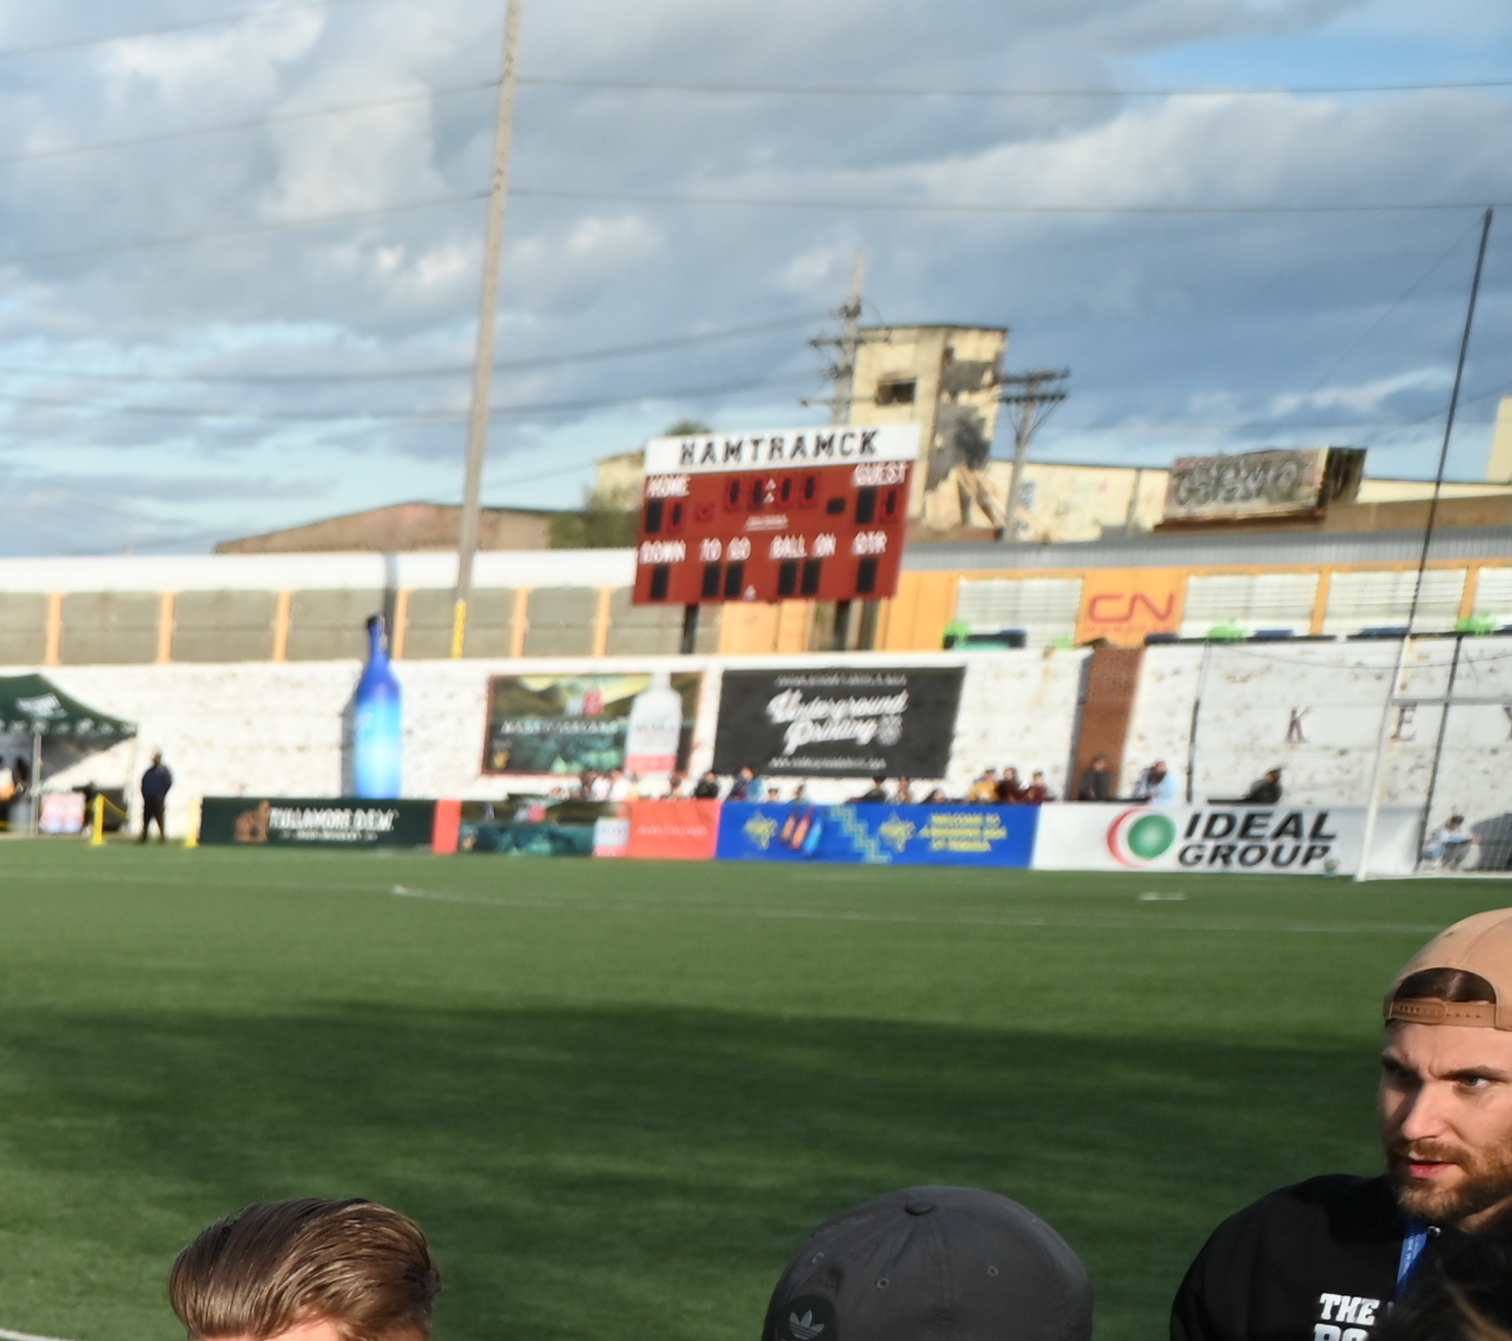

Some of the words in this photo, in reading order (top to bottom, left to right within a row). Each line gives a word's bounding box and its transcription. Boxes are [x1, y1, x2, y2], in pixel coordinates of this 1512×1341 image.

[679, 430, 879, 465] HAMTRAMCK
[646, 473, 690, 498] HOME
[852, 461, 907, 487] GUEST
[639, 539, 686, 565] DOWN
[769, 534, 807, 560] BALL
[1088, 593, 1175, 623] CN
[1184, 812, 1337, 840] IDEAL
[1178, 844, 1331, 868] GROUP
[1319, 1292, 1381, 1326] THE
